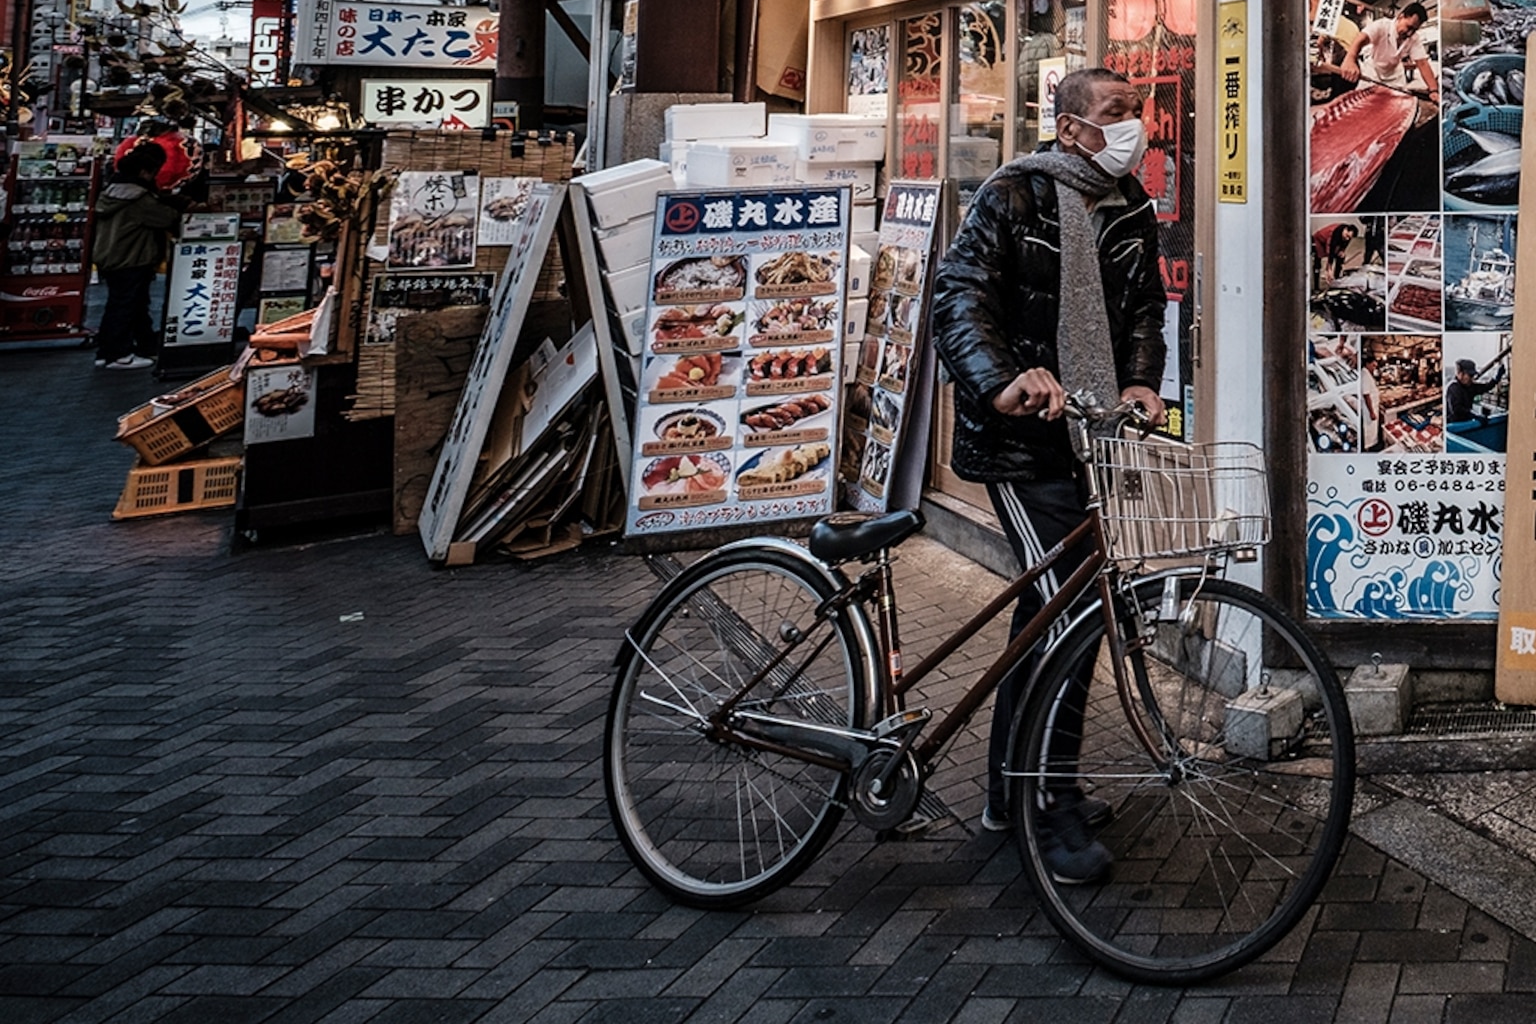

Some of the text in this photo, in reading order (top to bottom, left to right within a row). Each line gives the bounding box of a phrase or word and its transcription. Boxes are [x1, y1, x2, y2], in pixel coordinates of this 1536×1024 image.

[336, 7, 358, 56] 味の店
[369, 9, 467, 27] 日本一 本家
[358, 25, 472, 58] 大たこ
[376, 86, 480, 116] 串かつ
[1225, 57, 1240, 160] 一番搾り
[702, 194, 839, 230] 磯丸水産
[181, 244, 221, 255] 日本一
[22, 285, 59, 297] Coca-Cola
[217, 245, 240, 338] 創業昭和四十七年
[182, 283, 210, 336] 大たこ
[1377, 459, 1507, 476] 宴会ご予約承りま
[1362, 480, 1387, 493] 電話
[1360, 500, 1504, 535] 上 磯丸水
[1363, 537, 1502, 562] さかな貝加工セン
